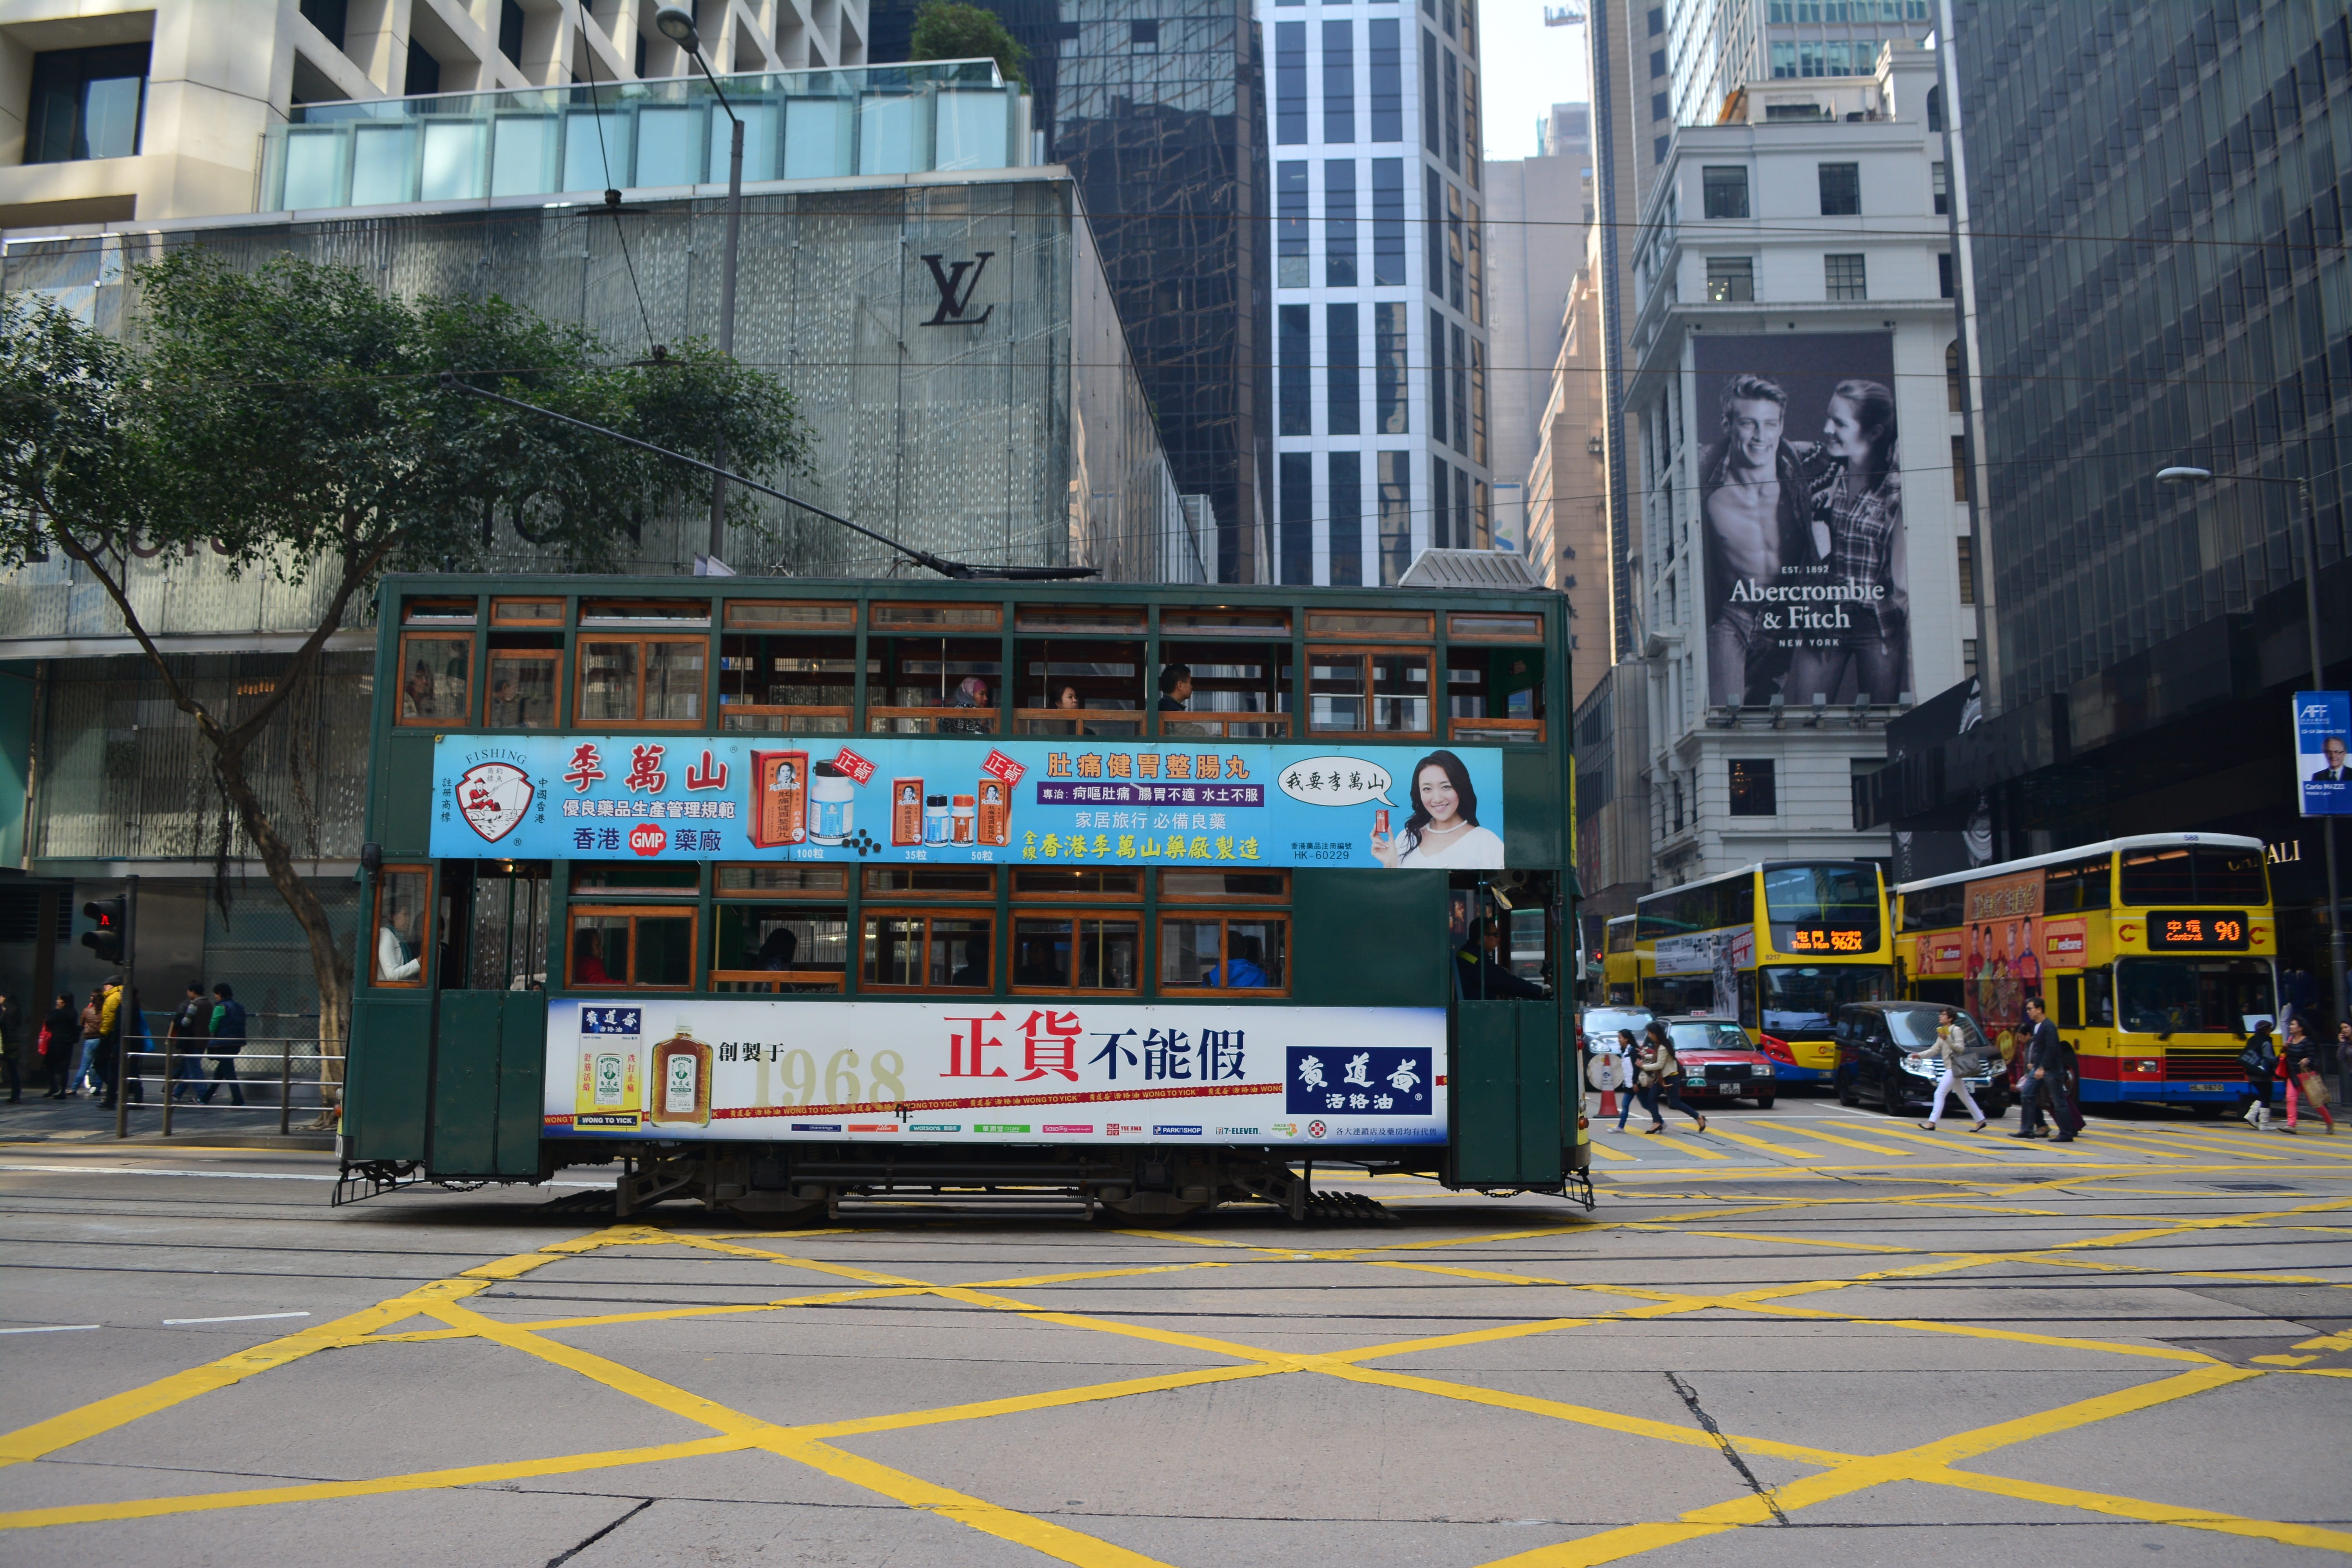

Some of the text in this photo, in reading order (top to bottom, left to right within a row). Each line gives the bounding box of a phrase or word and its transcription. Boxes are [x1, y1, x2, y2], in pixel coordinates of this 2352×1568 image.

[1806, 565, 1829, 573] 1892
[1729, 577, 1884, 602] Abercrombie
[1763, 604, 1851, 629] & Fitch
[2300, 705, 2328, 718] AFF
[465, 749, 526, 764] FISHING
[835, 751, 872, 781] 正貨
[1047, 752, 1250, 779] 肚痛健胃整腸丸
[562, 742, 729, 795] 李萬山
[985, 753, 1022, 782] 正貨
[1286, 771, 1384, 791] 我要李萬山
[535, 777, 548, 823] 中國香港
[1138, 787, 1195, 801] 腸胃不適
[1202, 788, 1258, 802] 水土不服
[563, 799, 735, 819] 優良藥品生產管理規範
[1076, 811, 1227, 830] 家居旅行 必備良藥
[573, 828, 722, 852] 香港 GMP 藥廠
[1040, 833, 1261, 860] 香港李萬山藥廠製造
[797, 848, 824, 859] 100粒
[906, 850, 927, 860] 35粒
[971, 850, 993, 860] 50粒
[1294, 851, 1349, 860] HK-60229
[1796, 931, 1824, 942] 屯門
[2214, 921, 2240, 941] 90
[939, 1010, 1082, 1082] 正貨
[1088, 1028, 1246, 1080] 不能假
[583, 1053, 592, 1091] 舒筋活絡
[626, 1054, 635, 1092] 跌打止痛
[749, 1049, 906, 1112] 1968
[1326, 1093, 1393, 1109] 活絡油
[894, 1103, 914, 1123] 年
[1336, 1127, 1437, 1136] 各大連鎖店及藥房均有代售
